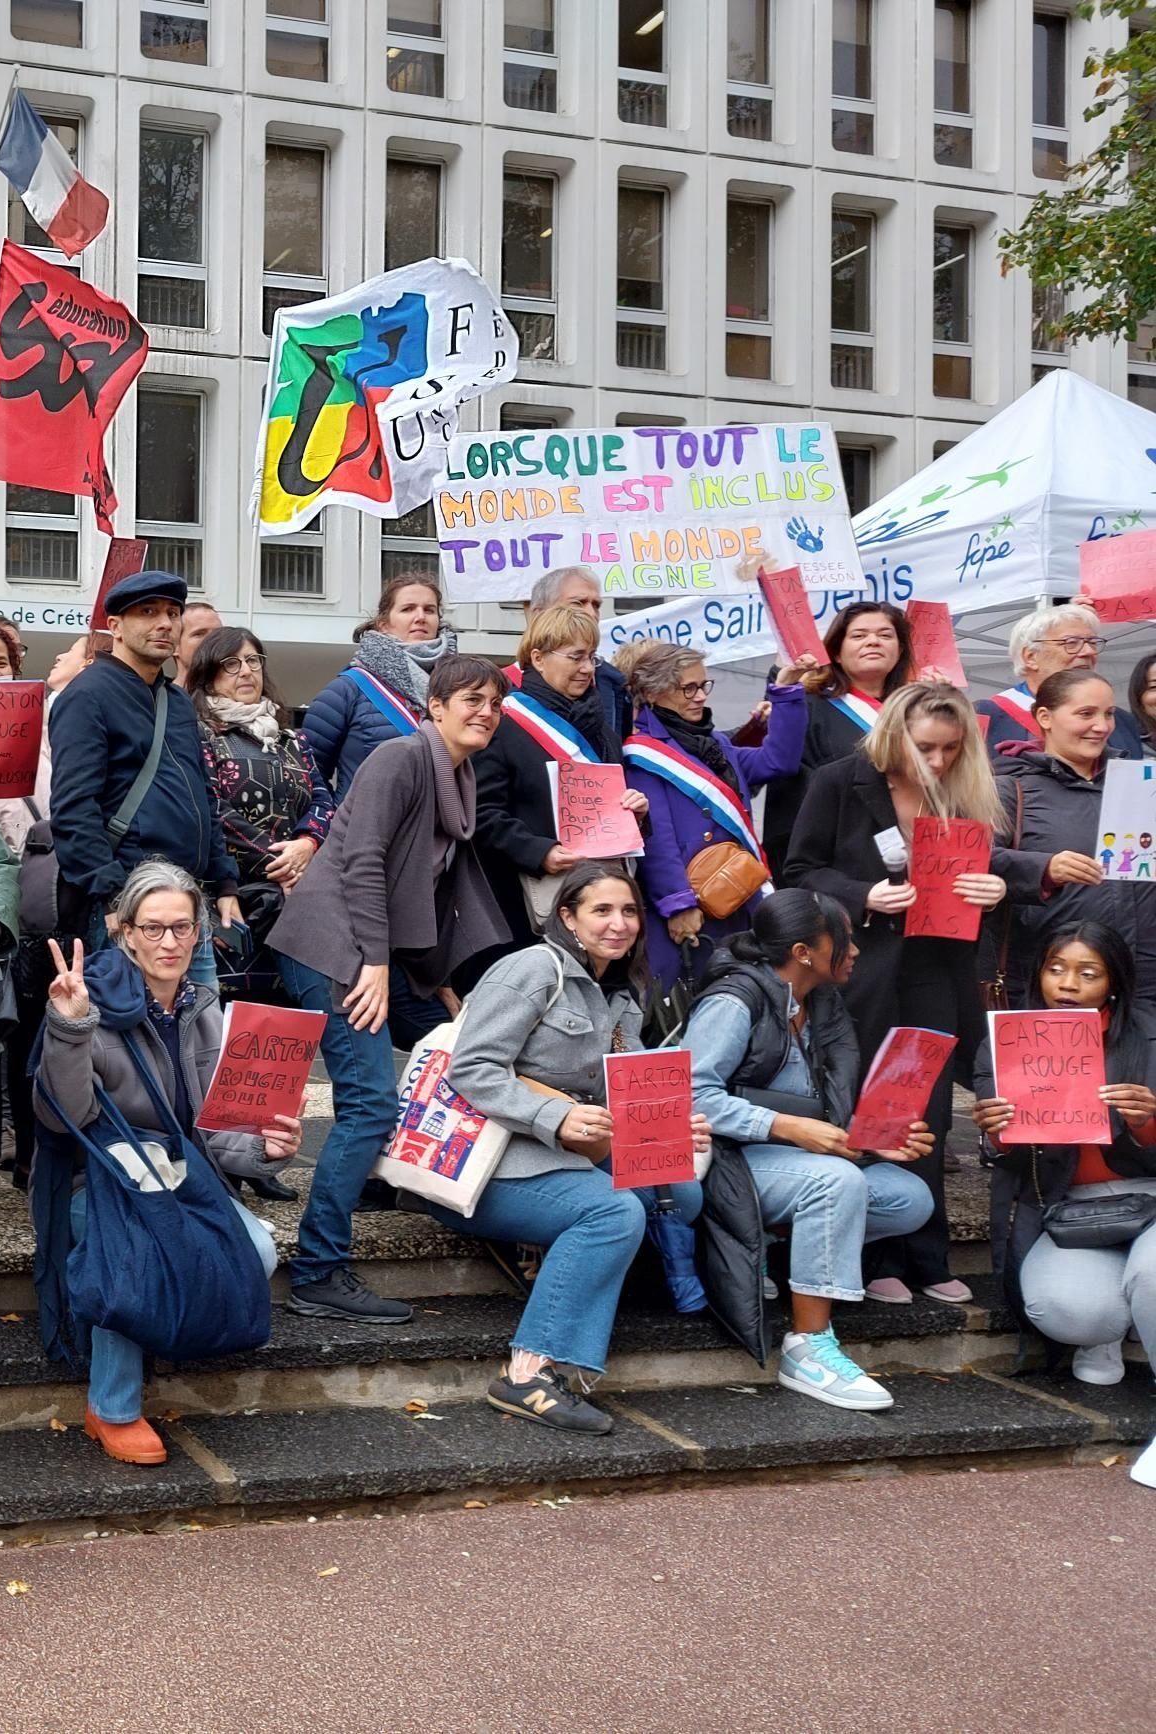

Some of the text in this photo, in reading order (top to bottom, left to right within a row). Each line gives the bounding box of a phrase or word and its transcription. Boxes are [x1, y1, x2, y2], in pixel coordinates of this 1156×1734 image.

[47, 291, 126, 341] éducation
[446, 426, 824, 481] LORSQUE TOUT LE
[439, 485, 585, 529] MONDE
[602, 475, 674, 513] EST
[439, 526, 766, 574] TOUT LE MONDE
[956, 532, 1016, 583] fcpe
[584, 562, 716, 592] AGNE
[804, 572, 856, 583] ACKSON
[12, 606, 35, 624] de
[227, 1031, 320, 1062] CARTON
[997, 1020, 1102, 1048] CARTON
[609, 1066, 692, 1091] CARTON
[1021, 1053, 1094, 1077] ROUGE
[1029, 1085, 1058, 1098] pour
[626, 1100, 682, 1124] ROUGE
[615, 1153, 694, 1176] L'INCLUSION
